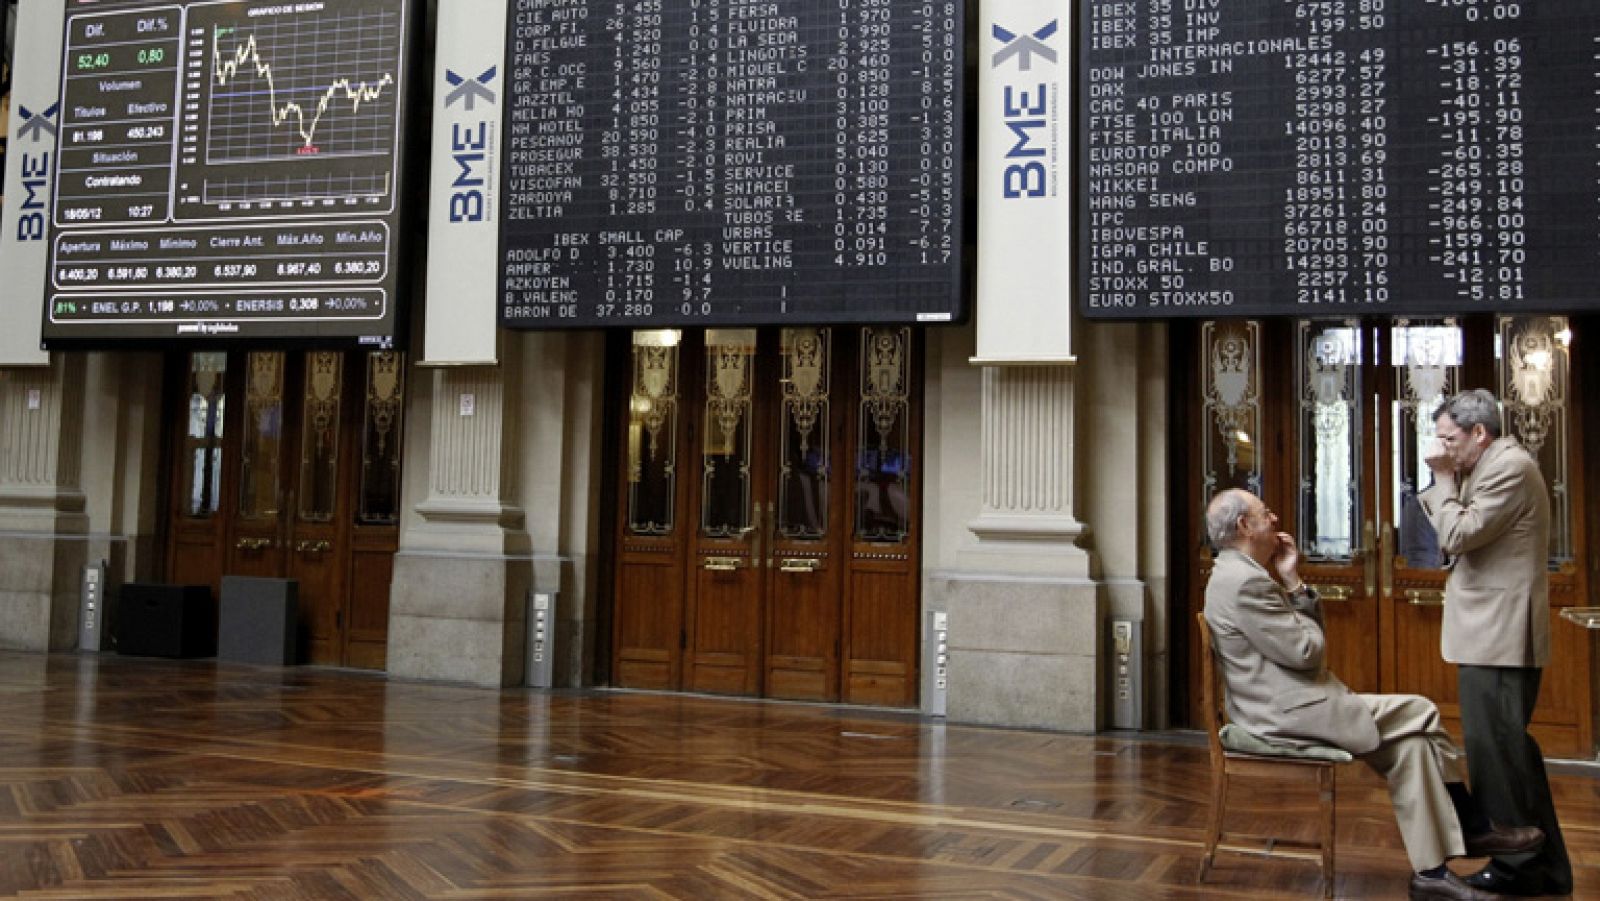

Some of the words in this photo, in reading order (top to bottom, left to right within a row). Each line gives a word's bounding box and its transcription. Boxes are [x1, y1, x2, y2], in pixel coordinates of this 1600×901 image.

[1093, 3, 1136, 18] IBEX
[1149, 1, 1171, 14] 35
[1185, 0, 1220, 10] DIV
[1093, 18, 1136, 34] IBEX
[1149, 16, 1171, 29] 35
[1187, 12, 1220, 26] INV
[1296, 0, 1384, 18] 6752.80
[1092, 35, 1136, 50] IBEX
[1149, 32, 1171, 45] 35
[1187, 28, 1220, 41] IMP
[1310, 16, 1384, 34] 199.50
[1466, 5, 1520, 21] 0.00
[77, 54, 110, 70] 52,40
[137, 48, 164, 64] 0,80
[1151, 35, 1332, 60] INTERNACIONALES
[1091, 68, 1124, 81] DOW
[1137, 63, 1196, 78] JONES
[1211, 59, 1232, 73] IN
[1285, 49, 1385, 68] 12442.49
[1426, 38, 1521, 58] -156.06
[99, 80, 142, 92] Volumen
[1091, 83, 1124, 97] DAX
[1296, 65, 1385, 83] 6277.57
[1440, 56, 1521, 73] -31.39
[1090, 99, 1124, 112] CAC
[1137, 96, 1159, 109] 40
[1173, 92, 1232, 108] PARIS
[1296, 81, 1385, 100] 2993.27
[1440, 73, 1522, 90] -18.72
[1090, 115, 1136, 129] FTSE
[1151, 111, 1184, 125] 100
[1198, 108, 1232, 123] LON
[1296, 99, 1386, 117] 5298.27
[1440, 91, 1520, 107] -40.11
[1090, 131, 1136, 145] FTSE
[1151, 125, 1220, 141] ITALIA
[1285, 116, 1386, 135] 14096.40
[1427, 108, 1522, 126] -195.90
[725, 135, 785, 150] REALIA
[837, 128, 889, 144] 0.625
[921, 127, 953, 140] 3.3
[1090, 144, 1172, 161] EUROTOP
[1187, 142, 1221, 157] 100
[1297, 133, 1386, 151] 2013.90
[1441, 126, 1523, 142] -11.78
[511, 162, 573, 177] TUBACEX
[677, 154, 716, 166] -2.0
[725, 152, 763, 166] ROVI
[837, 144, 888, 159] 5.040
[921, 142, 953, 154] 0.0
[1090, 162, 1159, 177] NASDAQ
[1173, 158, 1233, 173] COMPO
[1297, 150, 1387, 168] 2813.69
[1441, 144, 1523, 159] -60.35
[510, 176, 582, 191] VISCOFAN
[600, 172, 657, 187] 32.550
[677, 168, 715, 182] -1.5
[725, 165, 794, 180] SERVICE
[836, 161, 888, 175] 0.130
[921, 159, 952, 171] 0.0
[1090, 178, 1158, 193] NIKKEI
[1297, 167, 1385, 184] 8611.31
[1429, 161, 1523, 178] -265.28
[85, 175, 142, 188] Contratando
[510, 191, 572, 205] ZARDOYA
[676, 183, 715, 197] -0.5
[1090, 195, 1136, 209] HANG
[1149, 192, 1197, 207] SENG
[1285, 184, 1387, 202] 18951.80
[1429, 178, 1524, 196] -249.10
[508, 205, 563, 220] ZELTIA
[609, 201, 656, 215] 1.285
[685, 198, 713, 211] 0.4
[1091, 212, 1124, 226] IPC
[1285, 201, 1387, 219] 37261.24
[1429, 196, 1523, 213] -249.84
[553, 233, 589, 246] IBEX
[599, 231, 645, 245] SMALL
[656, 229, 684, 242] CAP
[722, 227, 773, 240] URBAS
[835, 223, 886, 236] 0.014
[920, 219, 951, 233] 7.7
[1091, 226, 1184, 243] IBOVESPA
[1285, 219, 1388, 236] 66718.00
[1429, 213, 1525, 230] -966.00
[210, 237, 240, 247] Cierre
[507, 249, 561, 261] ADOLFO
[571, 247, 580, 259] D
[608, 245, 654, 258] 3.400
[675, 243, 713, 256] -6.3
[722, 240, 793, 254] VERTICE
[835, 237, 885, 251] 0.091
[909, 235, 951, 249] -6.2
[1091, 244, 1136, 259] IGPA
[1149, 242, 1208, 256] CHILE
[1285, 236, 1388, 253] 20705.90
[1429, 231, 1525, 247] -159.90
[506, 263, 551, 275] AMPER
[608, 260, 654, 272] 1.730
[675, 258, 713, 270] 10.9
[723, 255, 793, 270] VUELING
[835, 251, 886, 266] 4.910
[921, 250, 951, 264] 1.7
[1210, 258, 1234, 272] BO
[1286, 253, 1388, 270] 14293.70
[1429, 249, 1526, 265] -241.70
[506, 277, 570, 289] AZKOYEN
[607, 274, 653, 287] 1.715
[673, 273, 712, 285] -1.4
[1090, 276, 1148, 291] STOXX
[1161, 275, 1184, 289] 50
[1298, 270, 1388, 287] 2257.16
[1443, 267, 1524, 283] -12.01
[505, 290, 578, 304] B.VALENC
[606, 289, 653, 301] 0.170
[682, 287, 712, 299] 9.7
[1089, 293, 1136, 308] EURO
[1149, 291, 1234, 306] STOXX50
[1298, 288, 1388, 304] 2141.10
[1457, 285, 1524, 300] -5.81
[92, 302, 118, 313] ENEL
[504, 305, 550, 318] BARON
[560, 304, 577, 317] DE
[596, 304, 653, 317] 37.280
